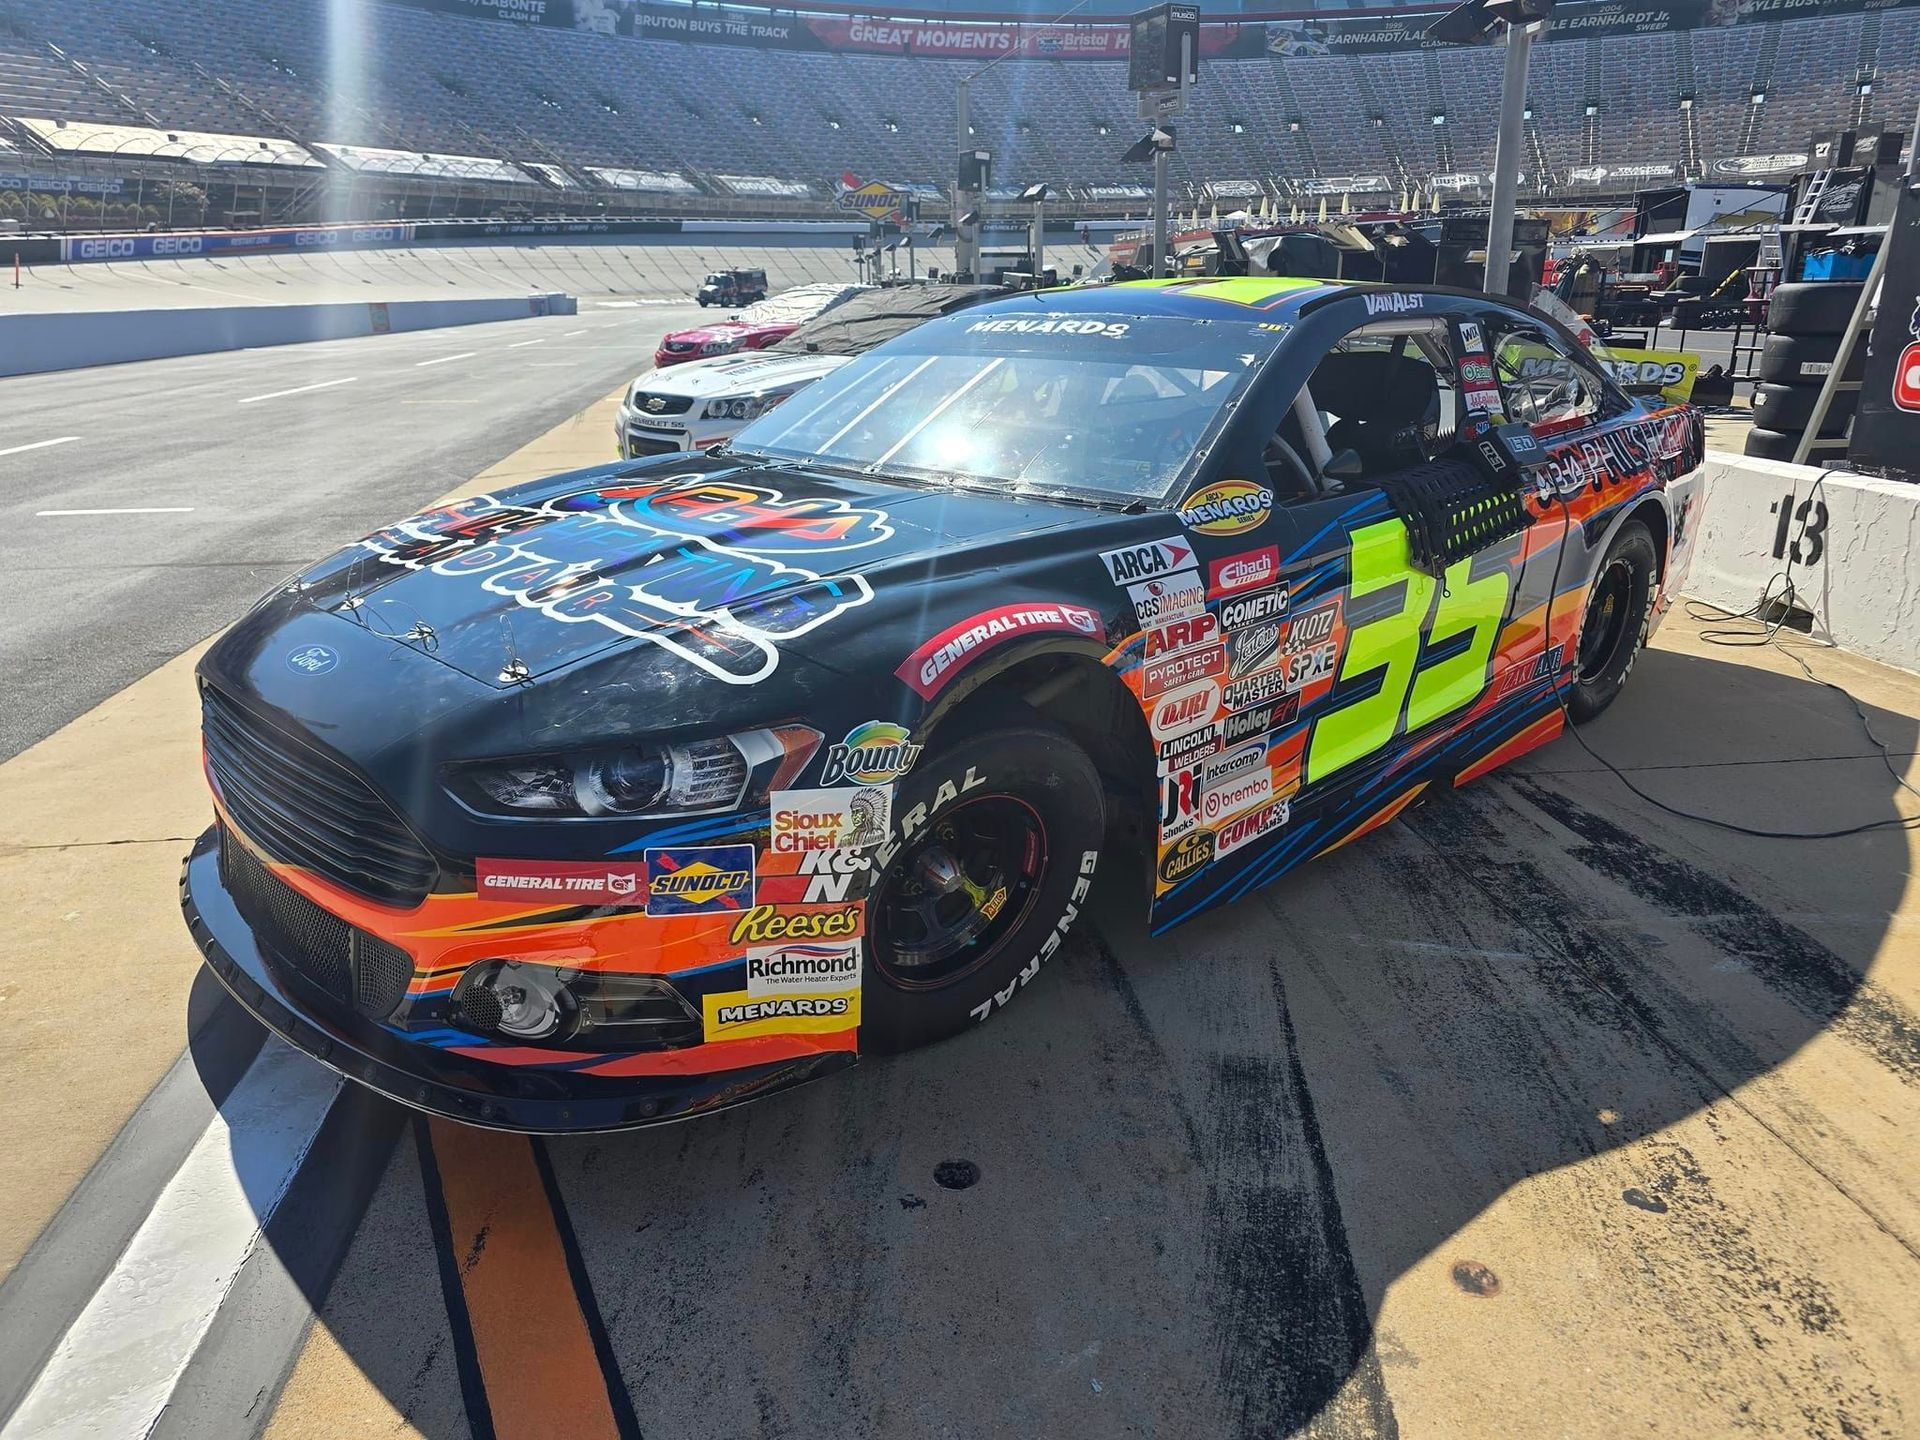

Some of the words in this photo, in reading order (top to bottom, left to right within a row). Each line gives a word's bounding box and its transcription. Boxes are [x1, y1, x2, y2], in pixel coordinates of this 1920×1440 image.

[498, 11, 528, 22] CLASH
[1551, 19, 1568, 30] LE
[1570, 11, 1652, 29] EARNHARDT
[1655, 11, 1671, 21] Jr.
[1600, 4, 1622, 13] 2004
[634, 14, 687, 30] BRUTON
[689, 20, 721, 34] BUYS
[725, 23, 748, 35] THE
[751, 26, 789, 39] TRACK
[850, 25, 912, 45] GREAT
[916, 30, 1010, 48] MOMENTS
[1064, 33, 1107, 46] Bristol
[1635, 22, 1668, 32] SWEEP
[28, 180, 72, 191] GEICO
[78, 182, 121, 194] GEICO
[843, 193, 900, 208] SUNOC
[152, 236, 202, 255] GEICO
[295, 232, 338, 246] GEICO
[353, 228, 393, 241] GEICO
[81, 239, 135, 257] GEICO
[965, 319, 1130, 337] MENARDS
[629, 415, 668, 428] CHEVROLET
[1176, 490, 1273, 526] MENARDS
[1237, 515, 1255, 524] SERIES
[1770, 495, 1829, 566] 13
[1114, 544, 1168, 581] ARCA
[1219, 554, 1271, 588] Eibach
[1222, 590, 1288, 627] COMETIC
[1146, 615, 1216, 658] ARP
[1228, 619, 1254, 631] GASKET
[1290, 608, 1335, 641] KLOTZ
[920, 615, 1017, 687] GENERAL
[1012, 610, 1063, 627] TIRE
[1308, 517, 1509, 784] 35
[1149, 650, 1220, 684] PYROTECT
[1163, 672, 1187, 688] SAFETY
[1187, 667, 1206, 680] GEAR
[1223, 669, 1281, 705] QUARTER
[1233, 680, 1283, 710] MASTER
[1227, 708, 1272, 739] Holley
[1271, 696, 1299, 722] EFI
[1163, 726, 1213, 759] LINCOLN
[820, 740, 922, 787] Bounty
[1174, 743, 1216, 770] WELDERS
[1222, 778, 1269, 807] brembo
[774, 810, 843, 832] Sioux
[1162, 818, 1194, 841] shocks
[1218, 804, 1274, 850] COMP
[1257, 814, 1283, 835] CAMS
[774, 831, 837, 852] Chief
[1166, 842, 1212, 879] CALLIES
[484, 875, 563, 891] GENERAL
[565, 876, 604, 891] TIRE
[653, 871, 747, 893] SUNOCO
[731, 904, 861, 944] Reese's
[970, 850, 1098, 1021] GENERAL
[749, 946, 857, 980] Richmond
[781, 976, 803, 985] Water
[804, 974, 829, 983] Heater
[830, 972, 857, 983] Experts
[718, 997, 849, 1025] MENARDS
